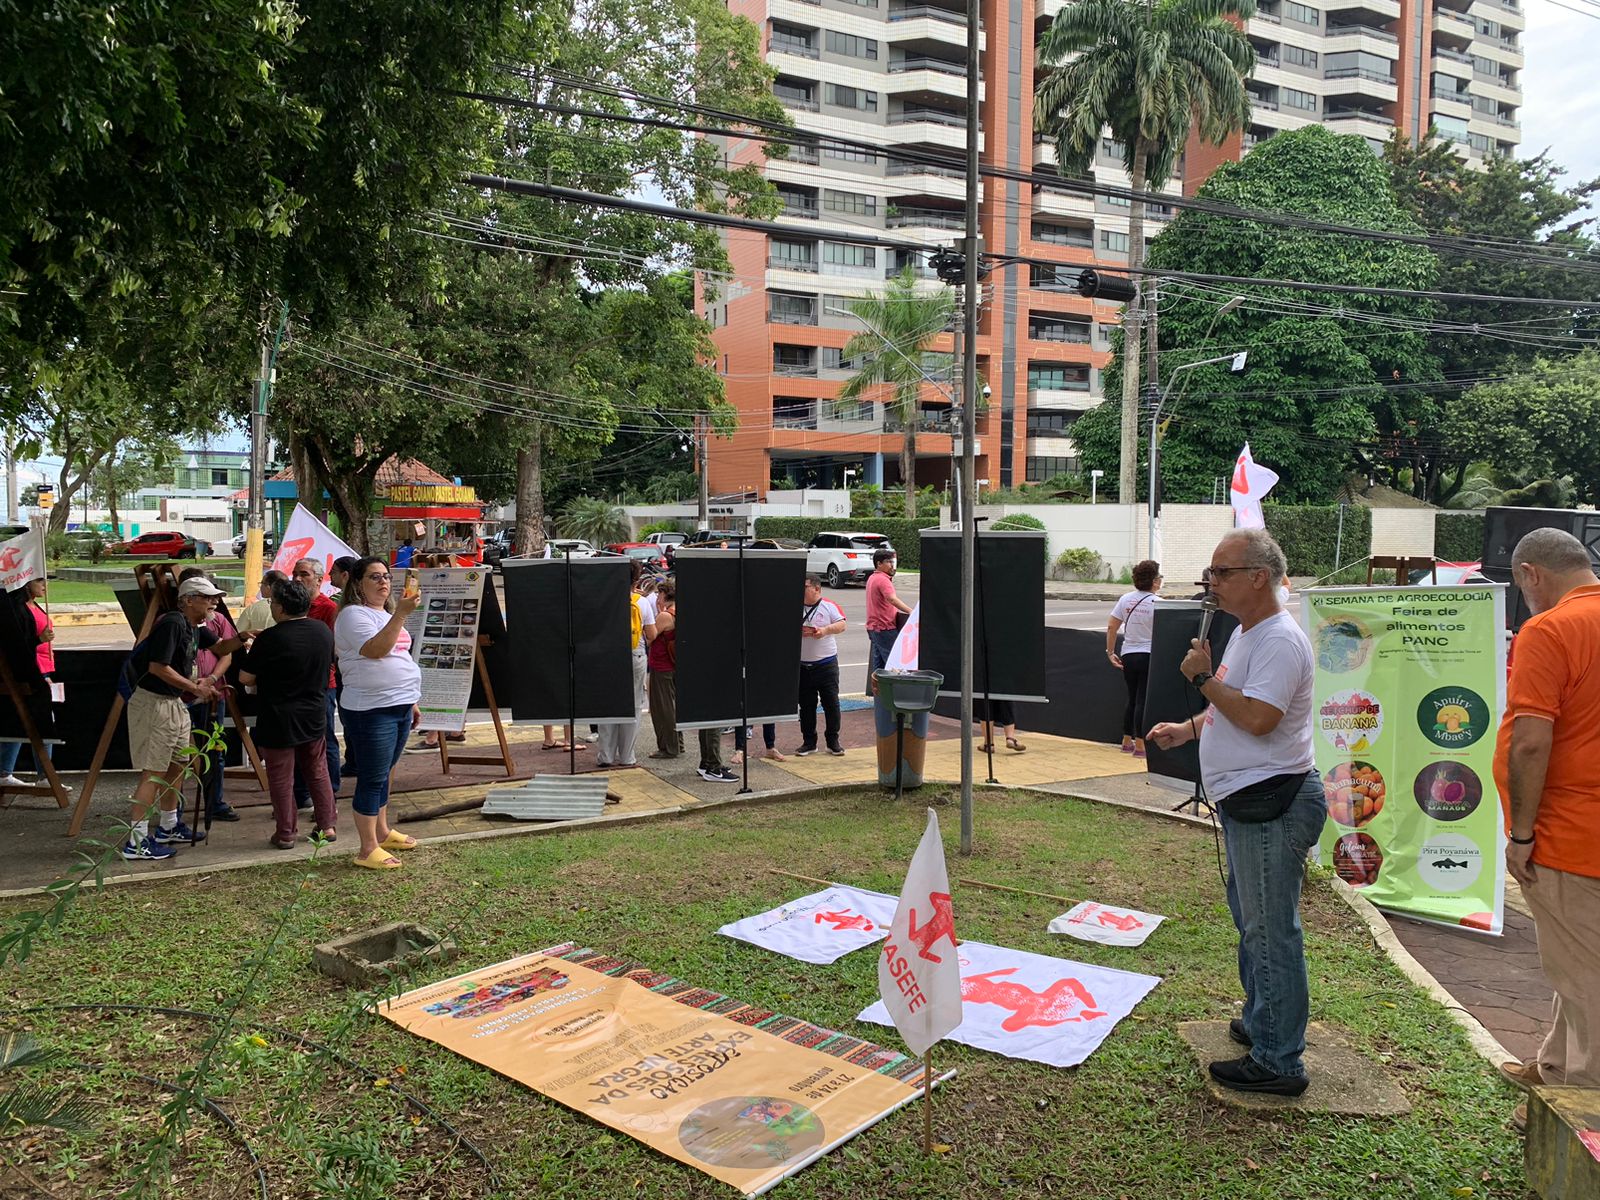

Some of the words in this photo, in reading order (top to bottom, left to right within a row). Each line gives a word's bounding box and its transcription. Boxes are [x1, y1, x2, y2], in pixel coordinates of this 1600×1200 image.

[391, 486, 412, 501] PASTEL
[413, 486, 434, 501] GOIANO
[435, 486, 454, 501] PASTEL
[455, 486, 475, 502] GOIANO
[1313, 597, 1323, 606] XI
[1326, 595, 1374, 605] SEMANA
[1377, 595, 1394, 604] DE
[1398, 592, 1493, 603] AGROECOLOGIA
[1392, 607, 1432, 616] Feira
[1437, 606, 1458, 616] de
[1386, 620, 1466, 631] alimentos
[1402, 637, 1448, 646] PANC
[1320, 705, 1366, 715] KETCHUP
[1367, 704, 1380, 714] DE
[1322, 717, 1378, 730] BANANA
[883, 934, 927, 1014] ASEFE
[663, 1031, 716, 1058] ARTE
[588, 1052, 668, 1088] NEGRA
[788, 1066, 834, 1092] novembro
[836, 1073, 855, 1083] 21
[806, 1090, 824, 1099] de
[817, 1083, 838, 1093] 24
[588, 1088, 630, 1105] DA
